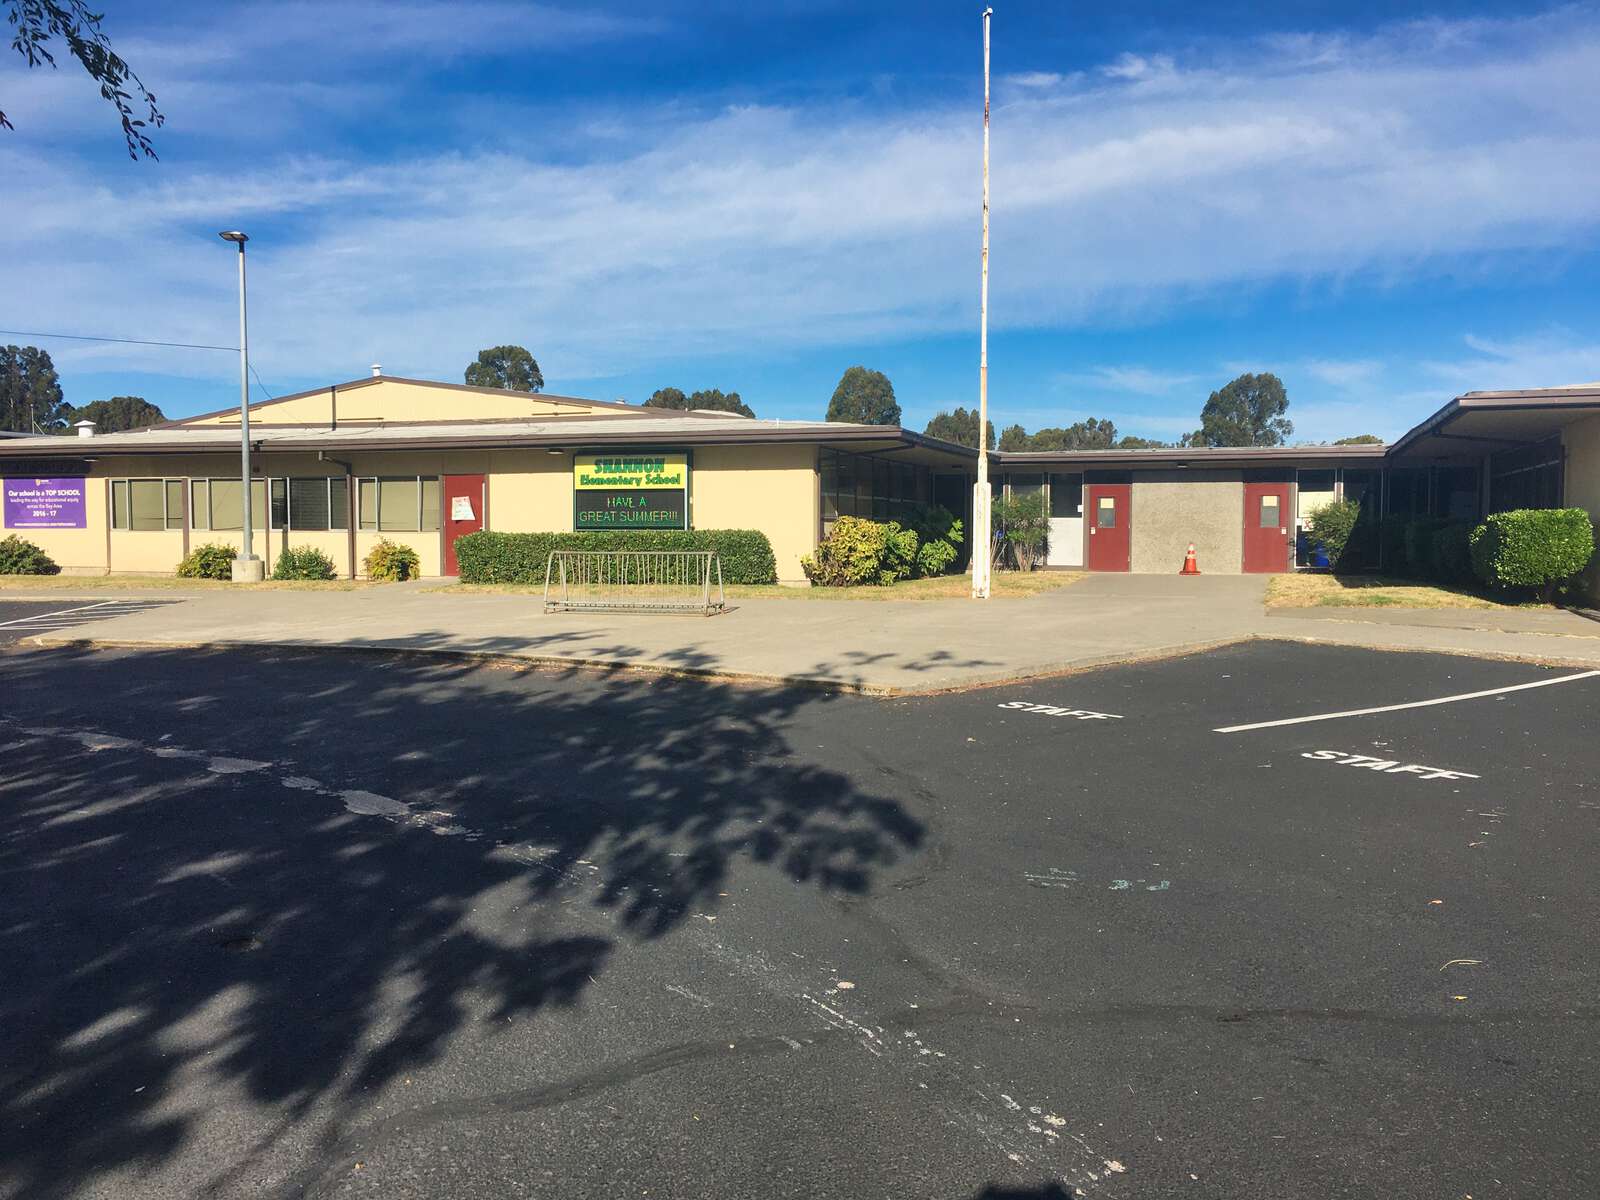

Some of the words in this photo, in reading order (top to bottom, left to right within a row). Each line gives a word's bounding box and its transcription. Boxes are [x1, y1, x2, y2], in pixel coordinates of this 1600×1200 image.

[594, 457, 665, 474] SHANNON
[580, 475, 643, 487] Elementary
[645, 473, 681, 485] School
[607, 496, 633, 508] HAVE
[639, 496, 647, 507] A
[579, 511, 616, 522] GREAT
[620, 510, 678, 522] SUMMER!!!
[997, 701, 1125, 720] STAFF
[1301, 750, 1482, 780] STAFF
